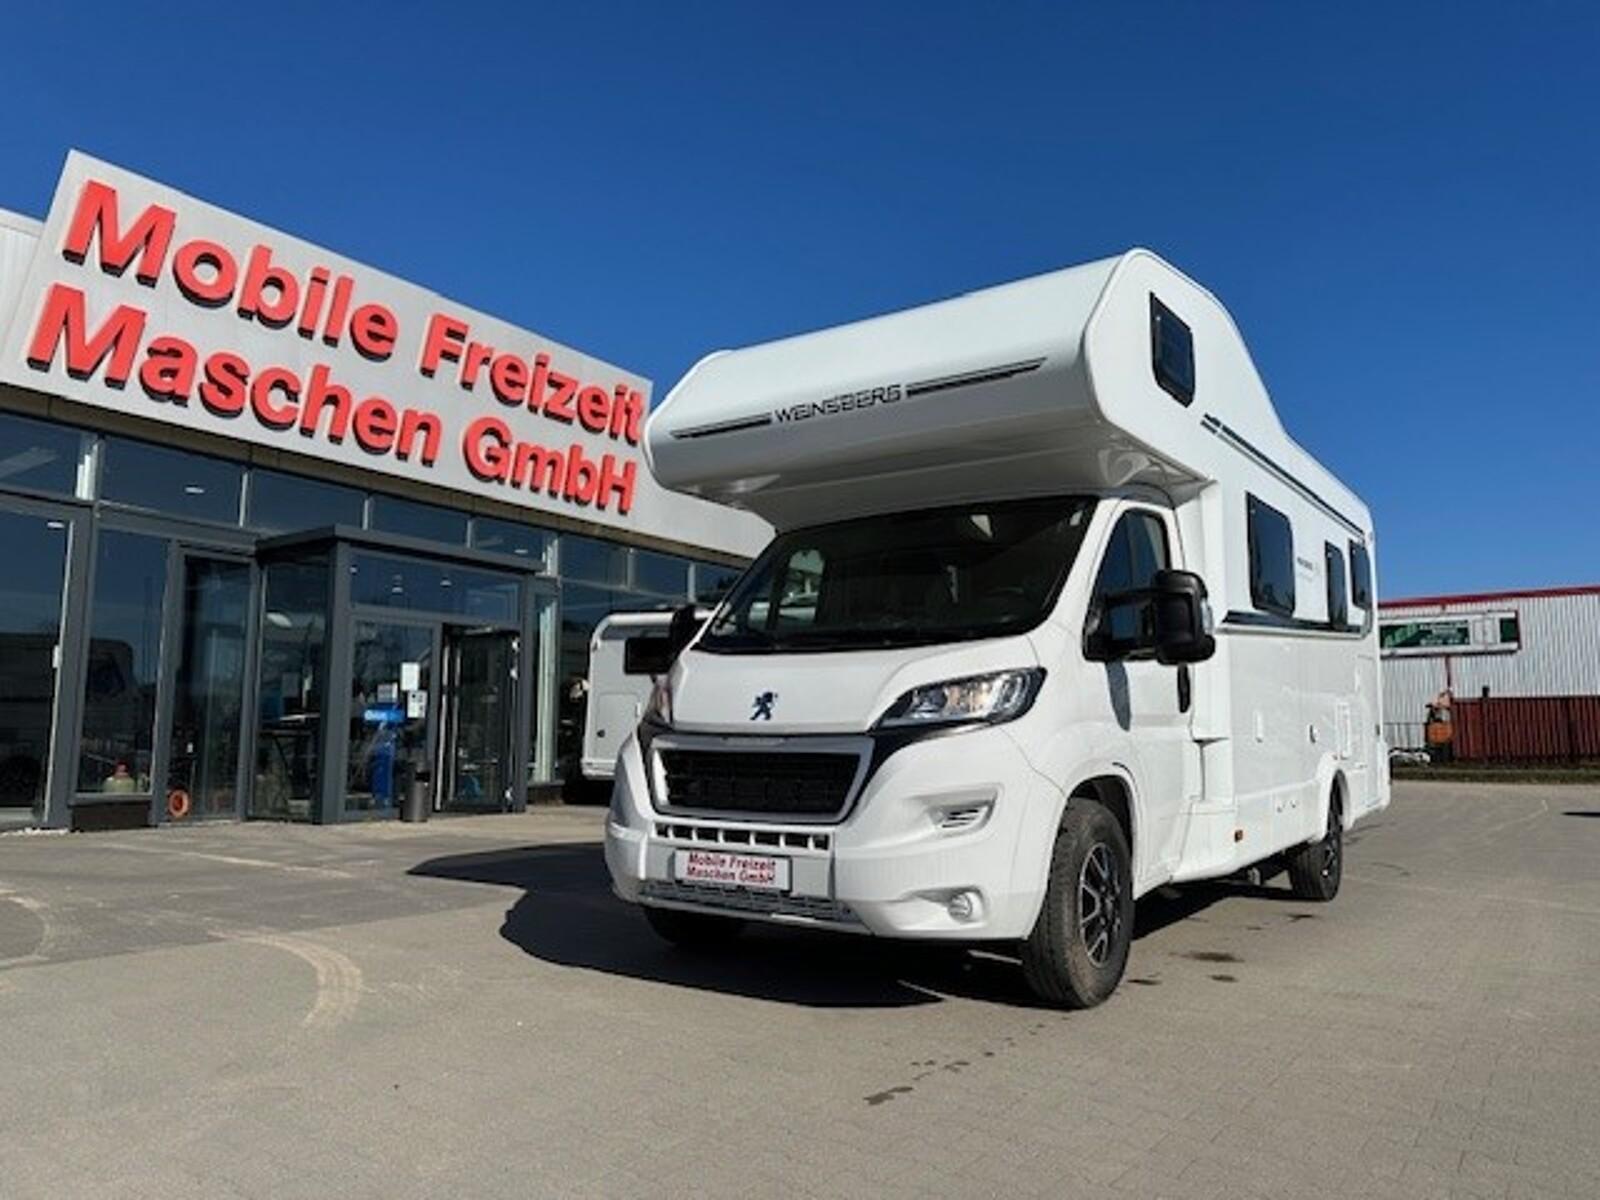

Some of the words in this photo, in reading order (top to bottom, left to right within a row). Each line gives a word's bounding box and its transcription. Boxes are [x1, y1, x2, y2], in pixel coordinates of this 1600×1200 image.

[63, 180, 398, 361] Mobile
[420, 314, 643, 446] Freizeit
[27, 283, 442, 466] Maschen
[462, 418, 636, 514] GmbH
[774, 384, 901, 423] WEINSBERG
[686, 866, 736, 880] Maschen
[738, 871, 775, 884] GmbH
[688, 853, 727, 867] Mobile
[729, 857, 776, 870] Freizeit
